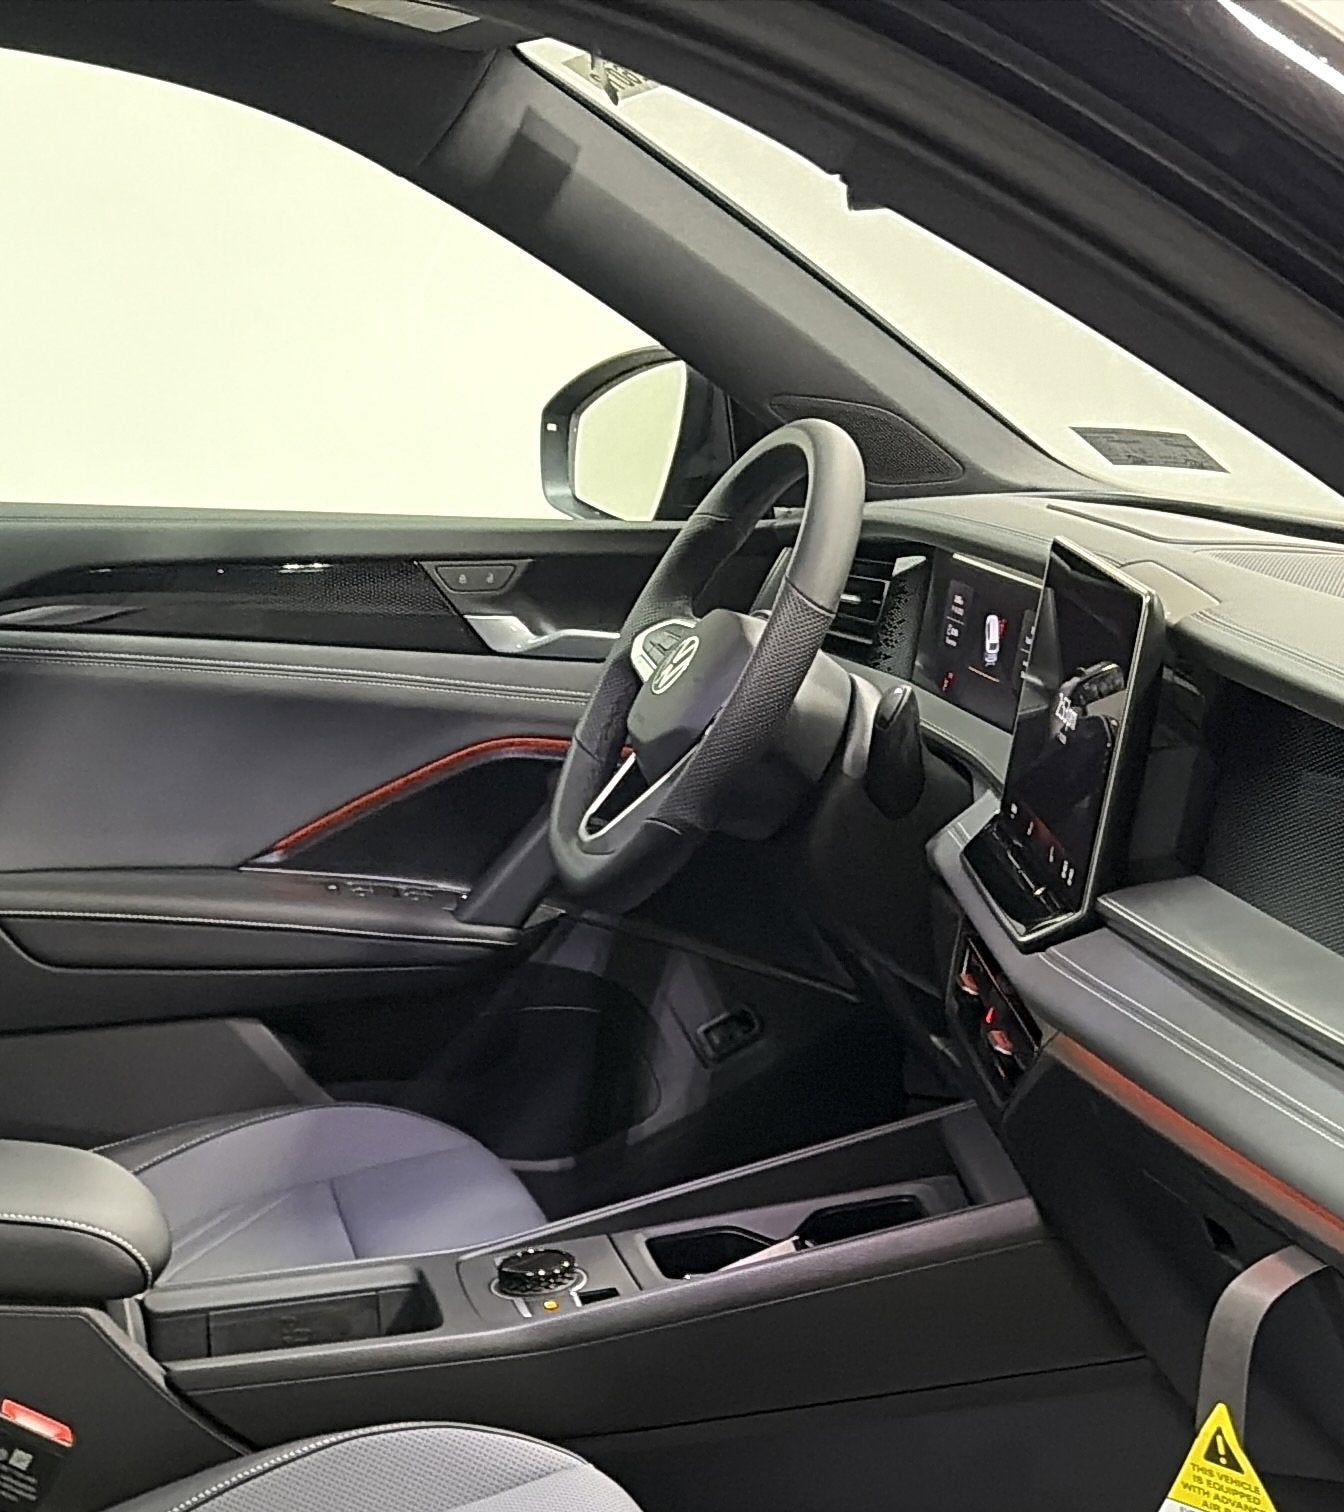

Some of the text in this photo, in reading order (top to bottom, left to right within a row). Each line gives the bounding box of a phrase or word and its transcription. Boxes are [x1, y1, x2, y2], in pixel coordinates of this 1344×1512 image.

[1181, 1481, 1210, 1498] WITH
[1190, 1462, 1261, 1495] THIS VEHICLE
[1193, 1475, 1261, 1506] IS EQUIPPED
[1202, 1500, 1221, 1512] AIR
